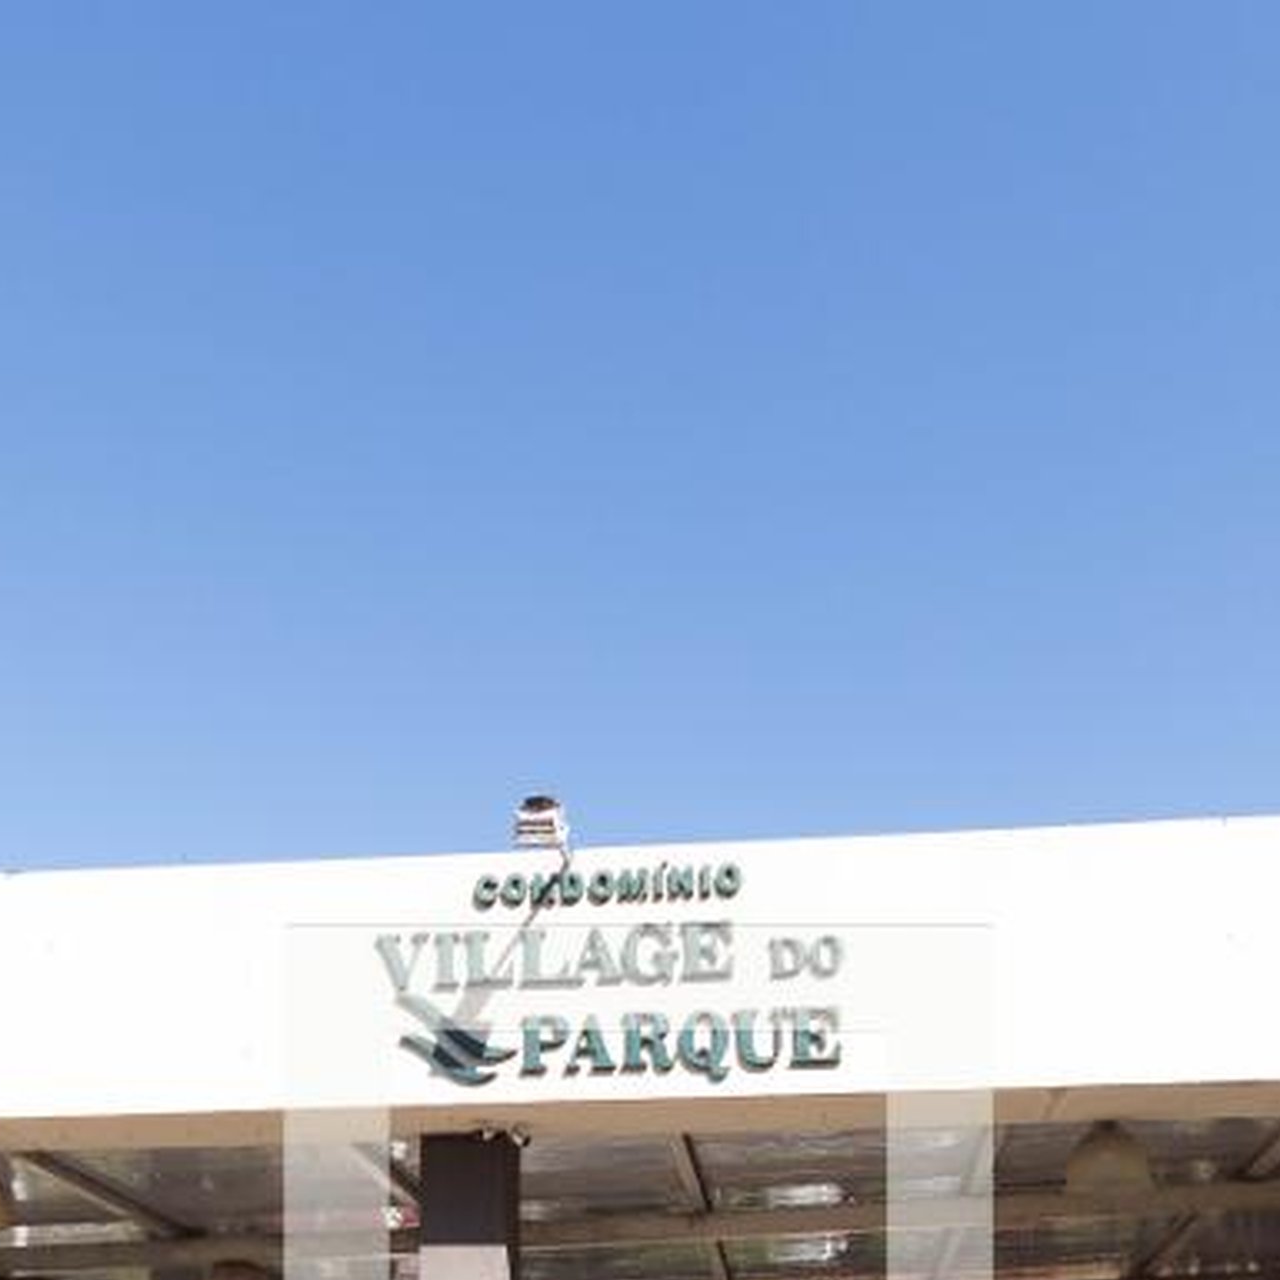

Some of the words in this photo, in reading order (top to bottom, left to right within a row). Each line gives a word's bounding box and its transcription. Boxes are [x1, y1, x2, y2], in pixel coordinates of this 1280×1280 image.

[473, 863, 743, 911] CONDOMÍNIO
[375, 922, 734, 993] VILLAGE
[767, 936, 844, 980] DO
[518, 1007, 844, 1082] PARQUE
